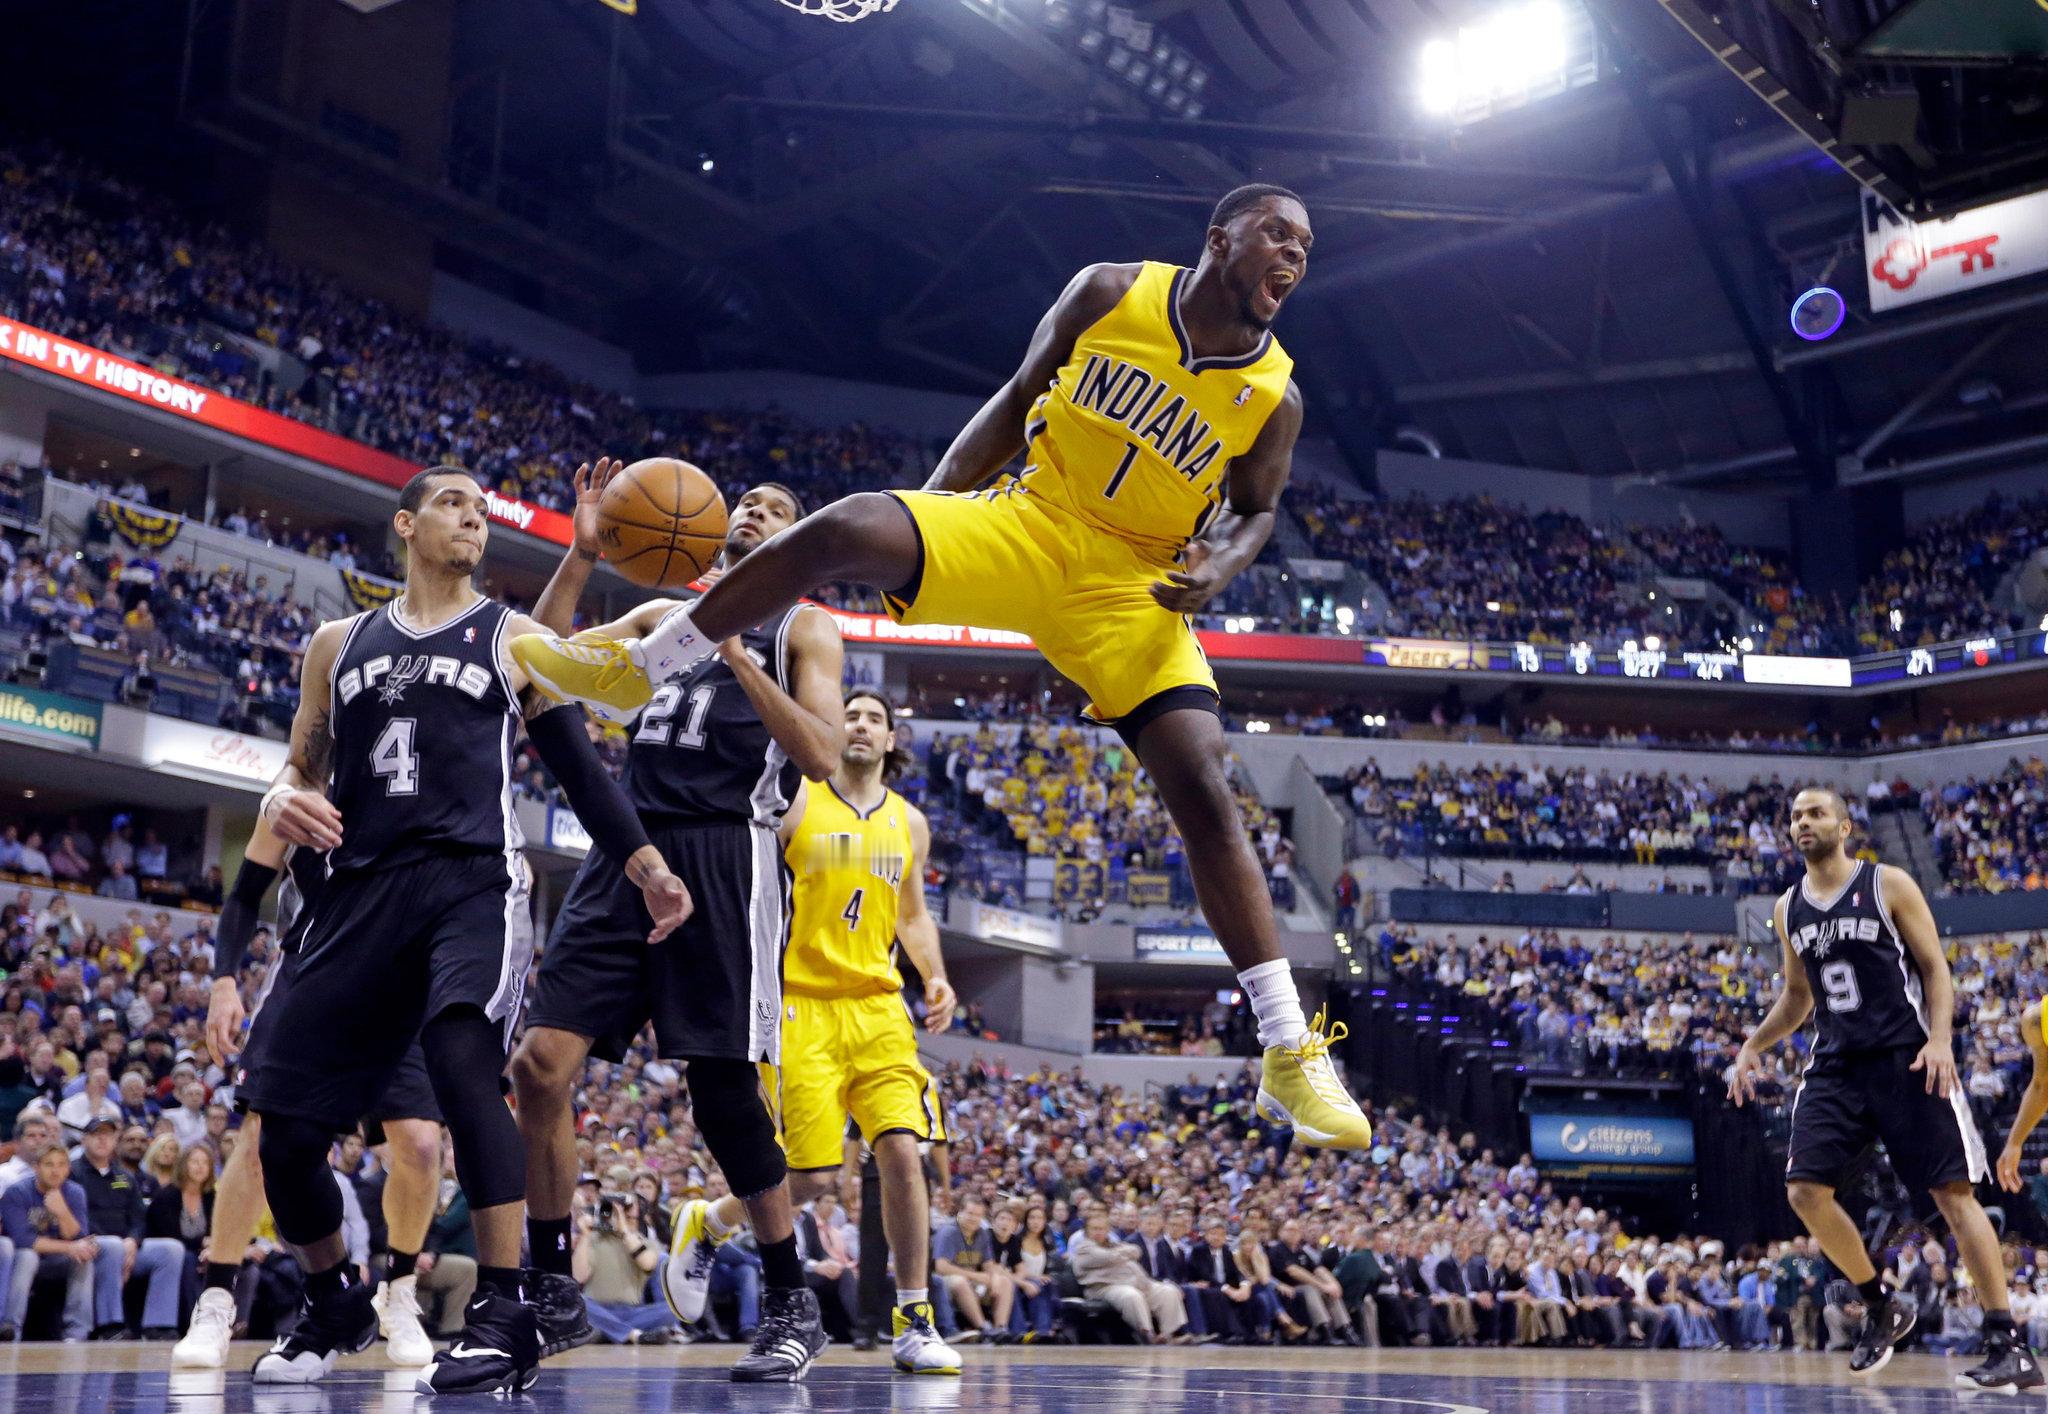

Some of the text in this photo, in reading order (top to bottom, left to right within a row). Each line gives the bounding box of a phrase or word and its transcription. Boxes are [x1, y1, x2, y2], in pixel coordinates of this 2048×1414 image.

[16, 330, 48, 361] IN
[53, 342, 92, 374] TV
[95, 357, 206, 413] HISTORY
[1072, 355, 1222, 482] INDIANA
[1102, 440, 1140, 499] 1
[338, 655, 492, 706] SPURS
[633, 683, 716, 751] 21
[369, 717, 420, 797] 4
[1058, 864, 1105, 899] 33
[841, 888, 865, 932] 4
[1137, 934, 1190, 951] SPORT
[1790, 917, 1880, 959] SPURS
[1820, 960, 1862, 1014] 9
[1588, 1125, 1653, 1144] citizens
[1589, 1142, 1664, 1156] energy group
